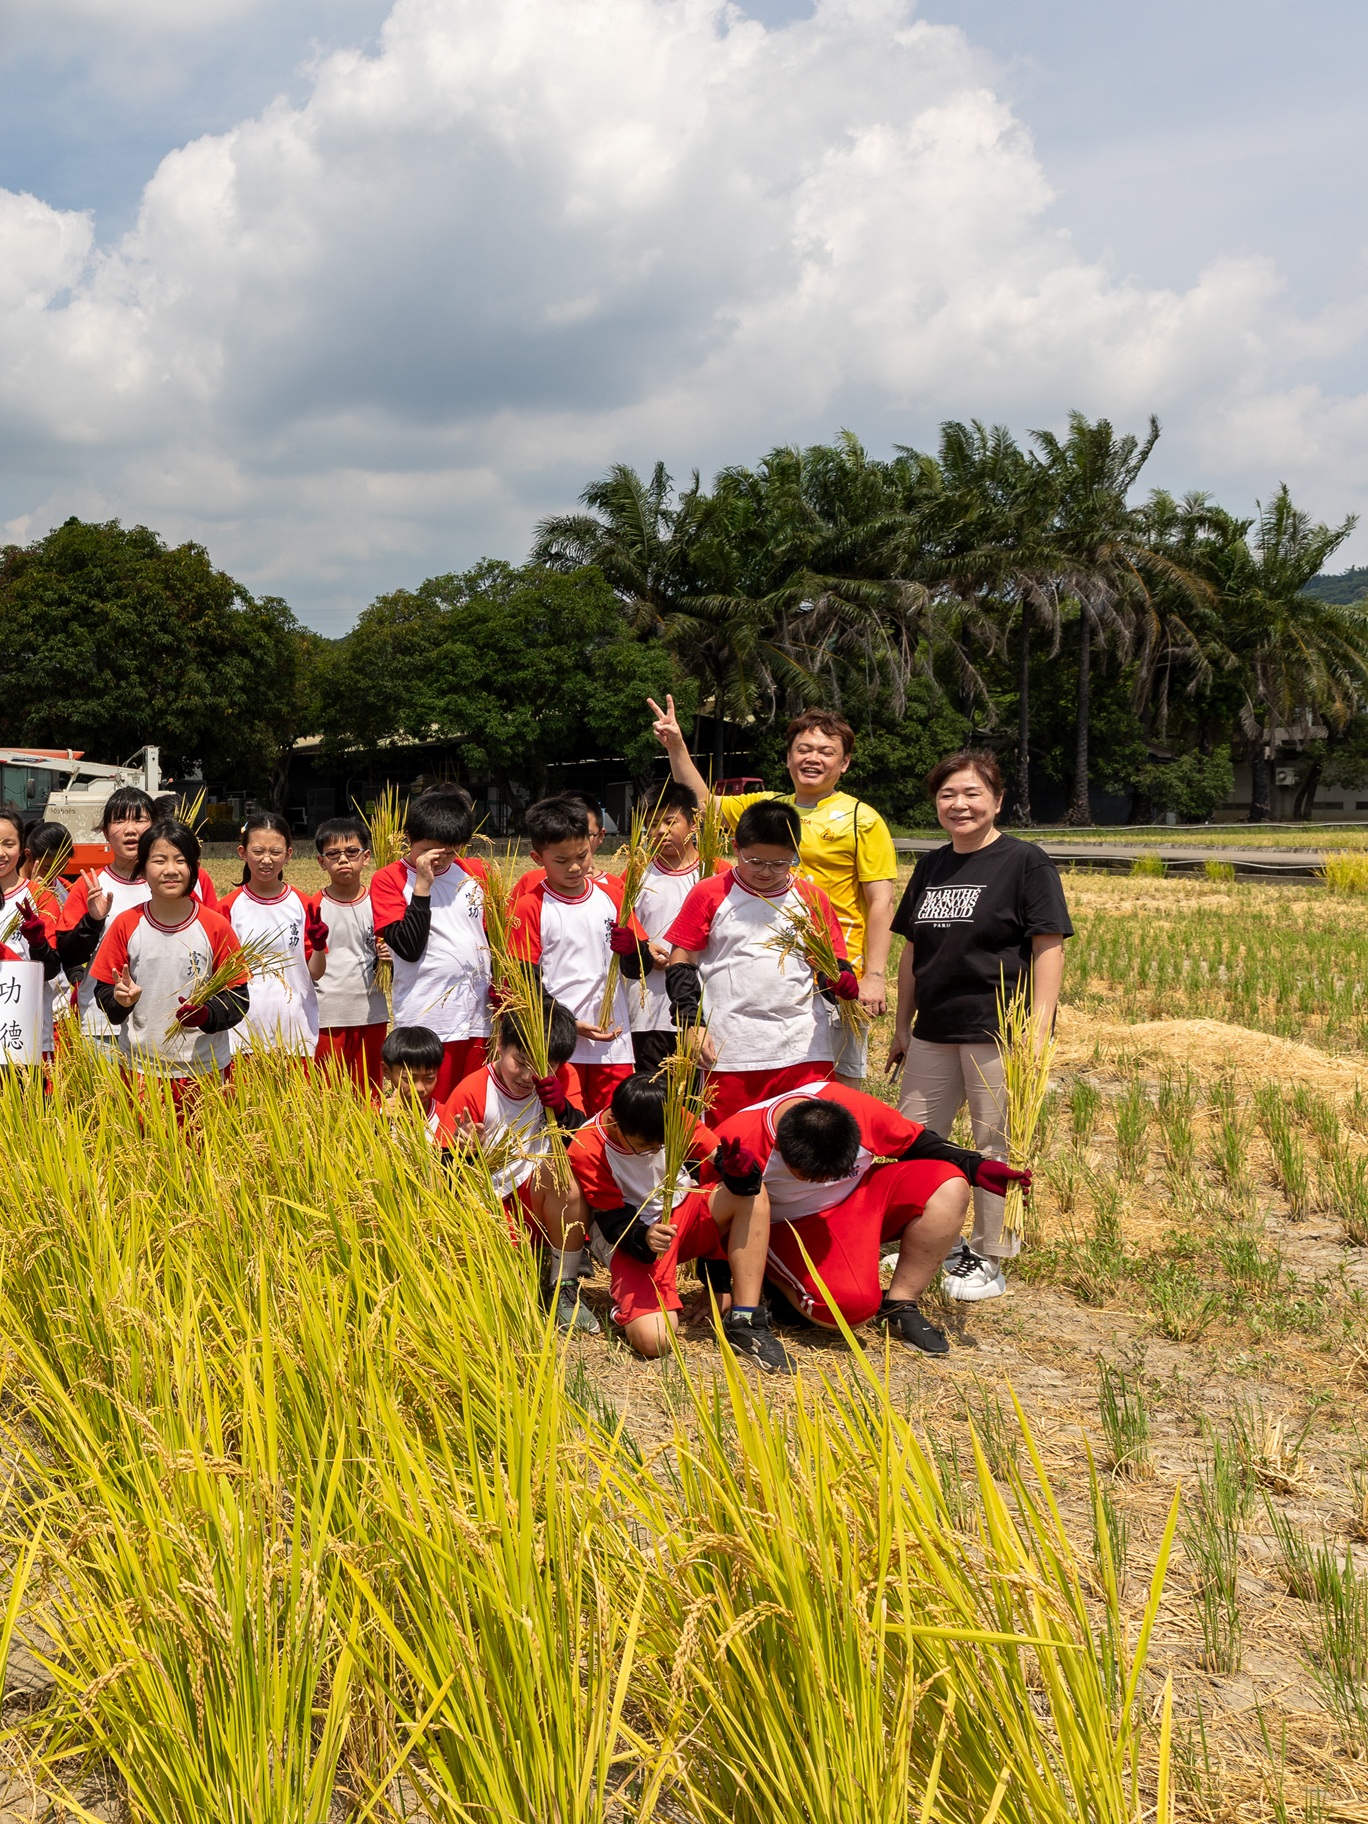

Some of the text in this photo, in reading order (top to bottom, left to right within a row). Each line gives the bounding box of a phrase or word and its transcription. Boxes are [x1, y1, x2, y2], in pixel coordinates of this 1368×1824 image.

[925, 888, 982, 900] MARITHÉ
[918, 907, 974, 919] GIRBAUD
[289, 922, 300, 947] 富功
